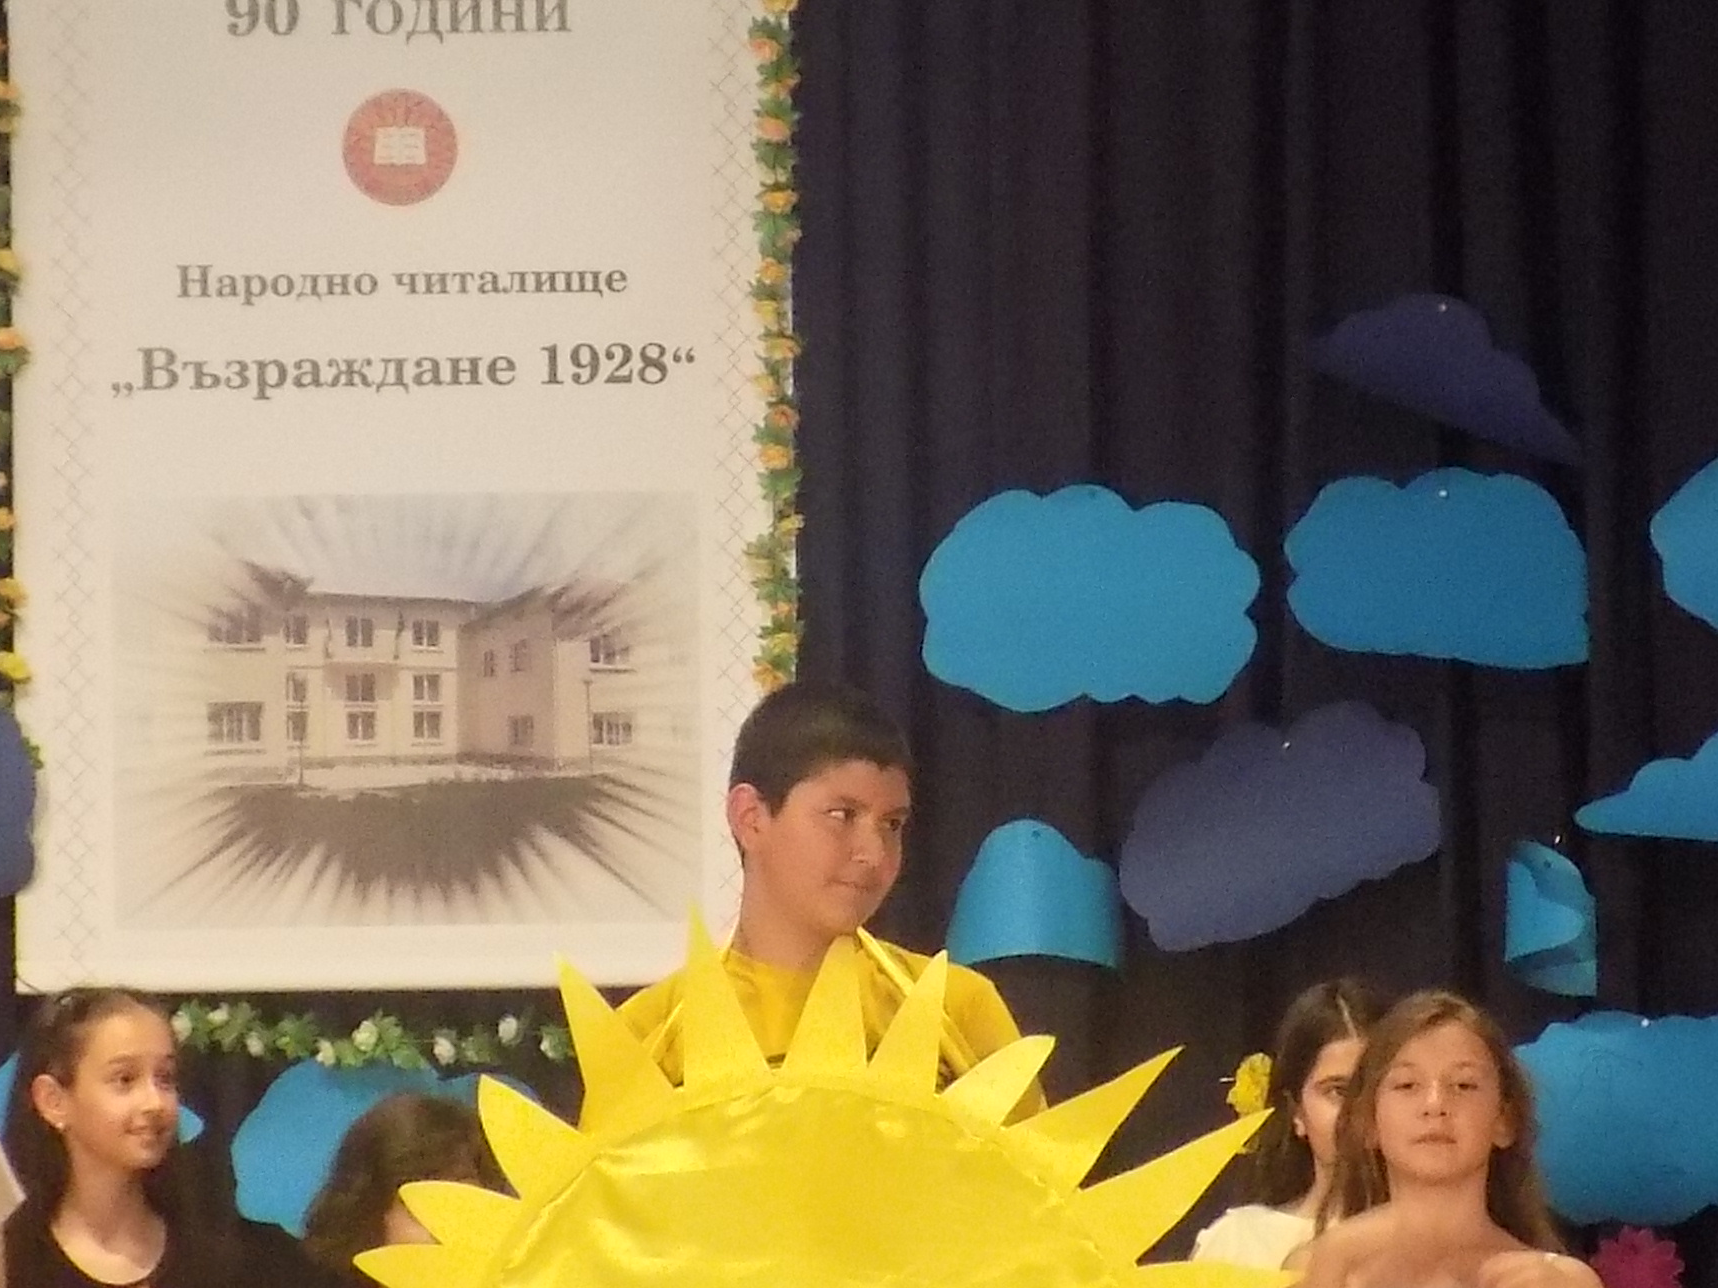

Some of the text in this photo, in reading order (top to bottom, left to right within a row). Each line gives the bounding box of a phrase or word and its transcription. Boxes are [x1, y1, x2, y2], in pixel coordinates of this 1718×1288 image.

[176, 264, 628, 306] Народно читалище
[111, 346, 517, 400] „Възраждане
